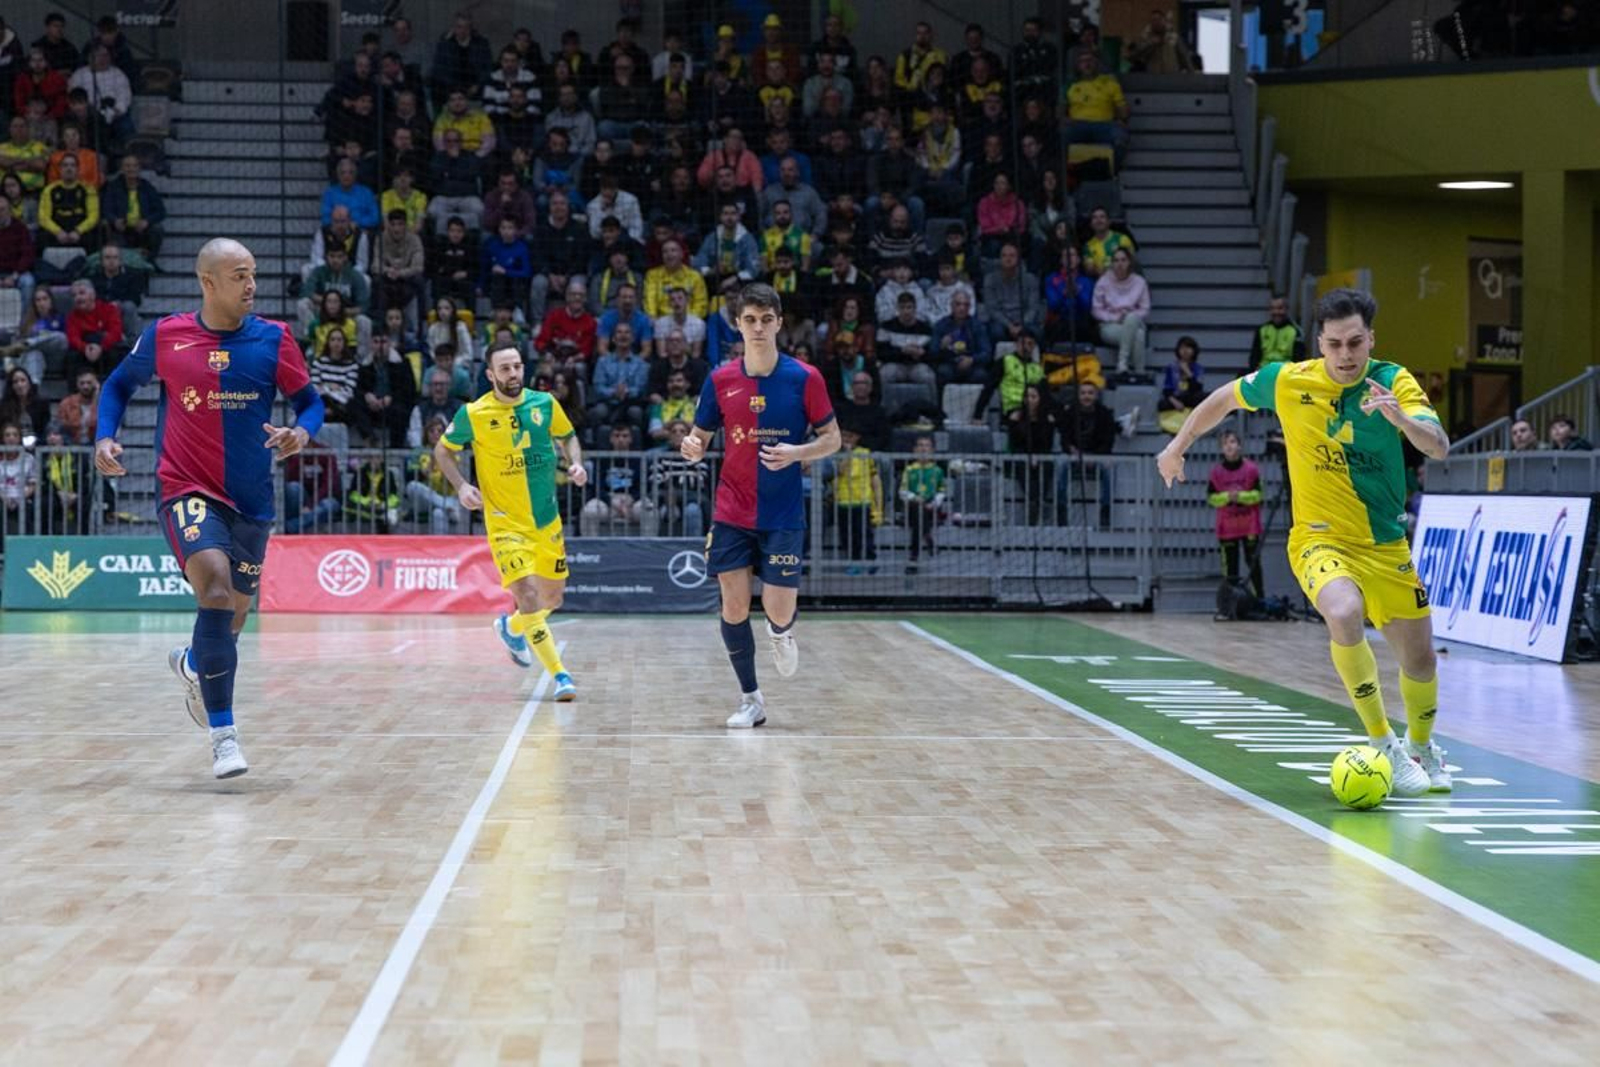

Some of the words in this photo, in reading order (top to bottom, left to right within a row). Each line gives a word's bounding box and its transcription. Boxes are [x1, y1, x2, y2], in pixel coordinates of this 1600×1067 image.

[1498, 327, 1523, 344] Pre
[172, 497, 207, 528] 19
[99, 555, 156, 573] CAJA
[138, 575, 195, 596] JAÉN
[395, 567, 460, 590] FUTSAL
